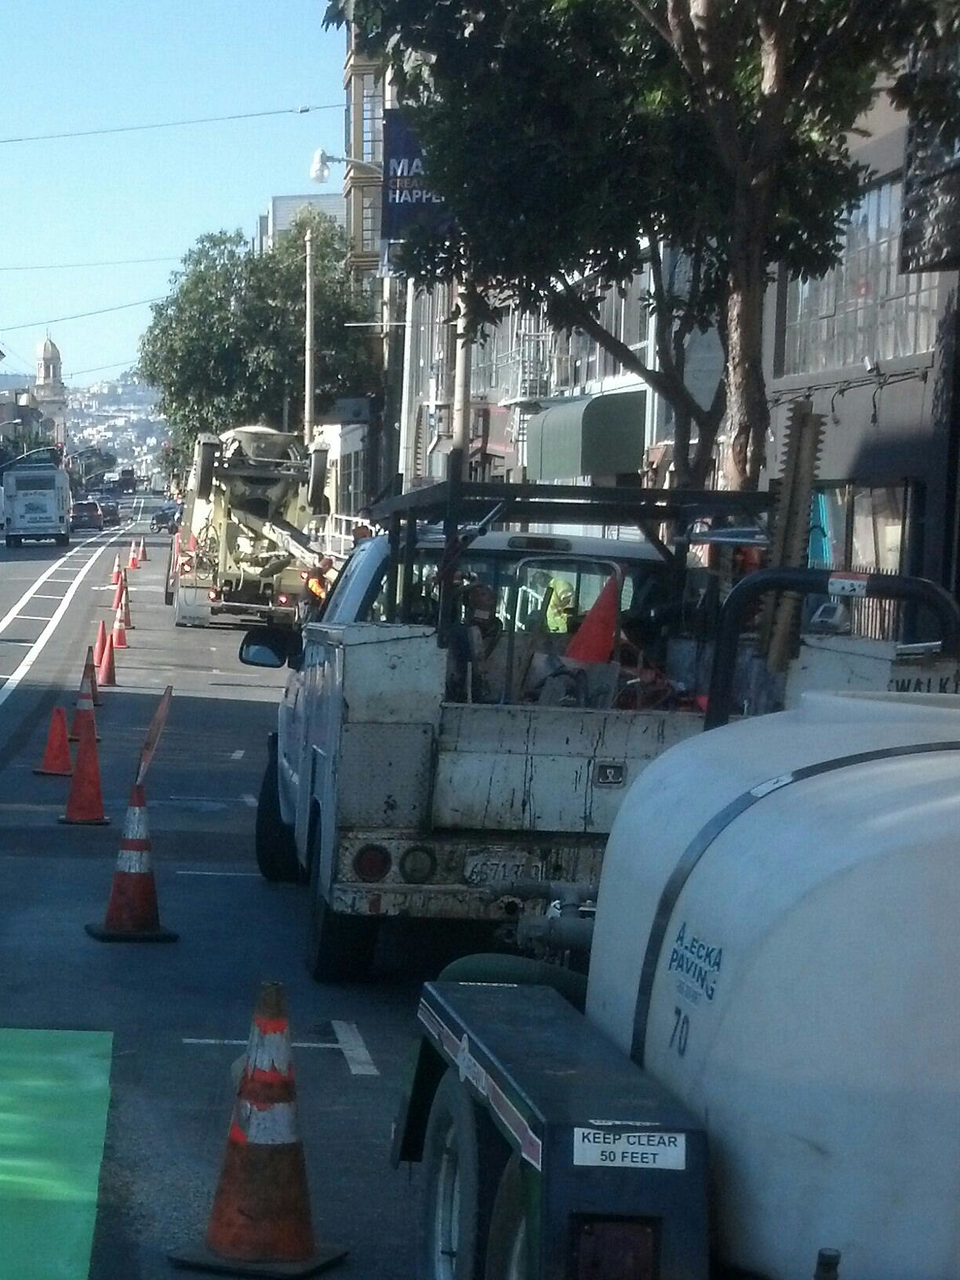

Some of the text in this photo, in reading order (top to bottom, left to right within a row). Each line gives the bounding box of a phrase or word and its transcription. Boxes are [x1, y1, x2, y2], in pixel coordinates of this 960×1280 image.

[389, 189, 445, 203] HAPPE
[668, 947, 717, 1001] PAVING
[669, 1006, 690, 1057] 70
[581, 1131, 678, 1148] KEEP CLEAR
[600, 1150, 660, 1164] 50 FEET
